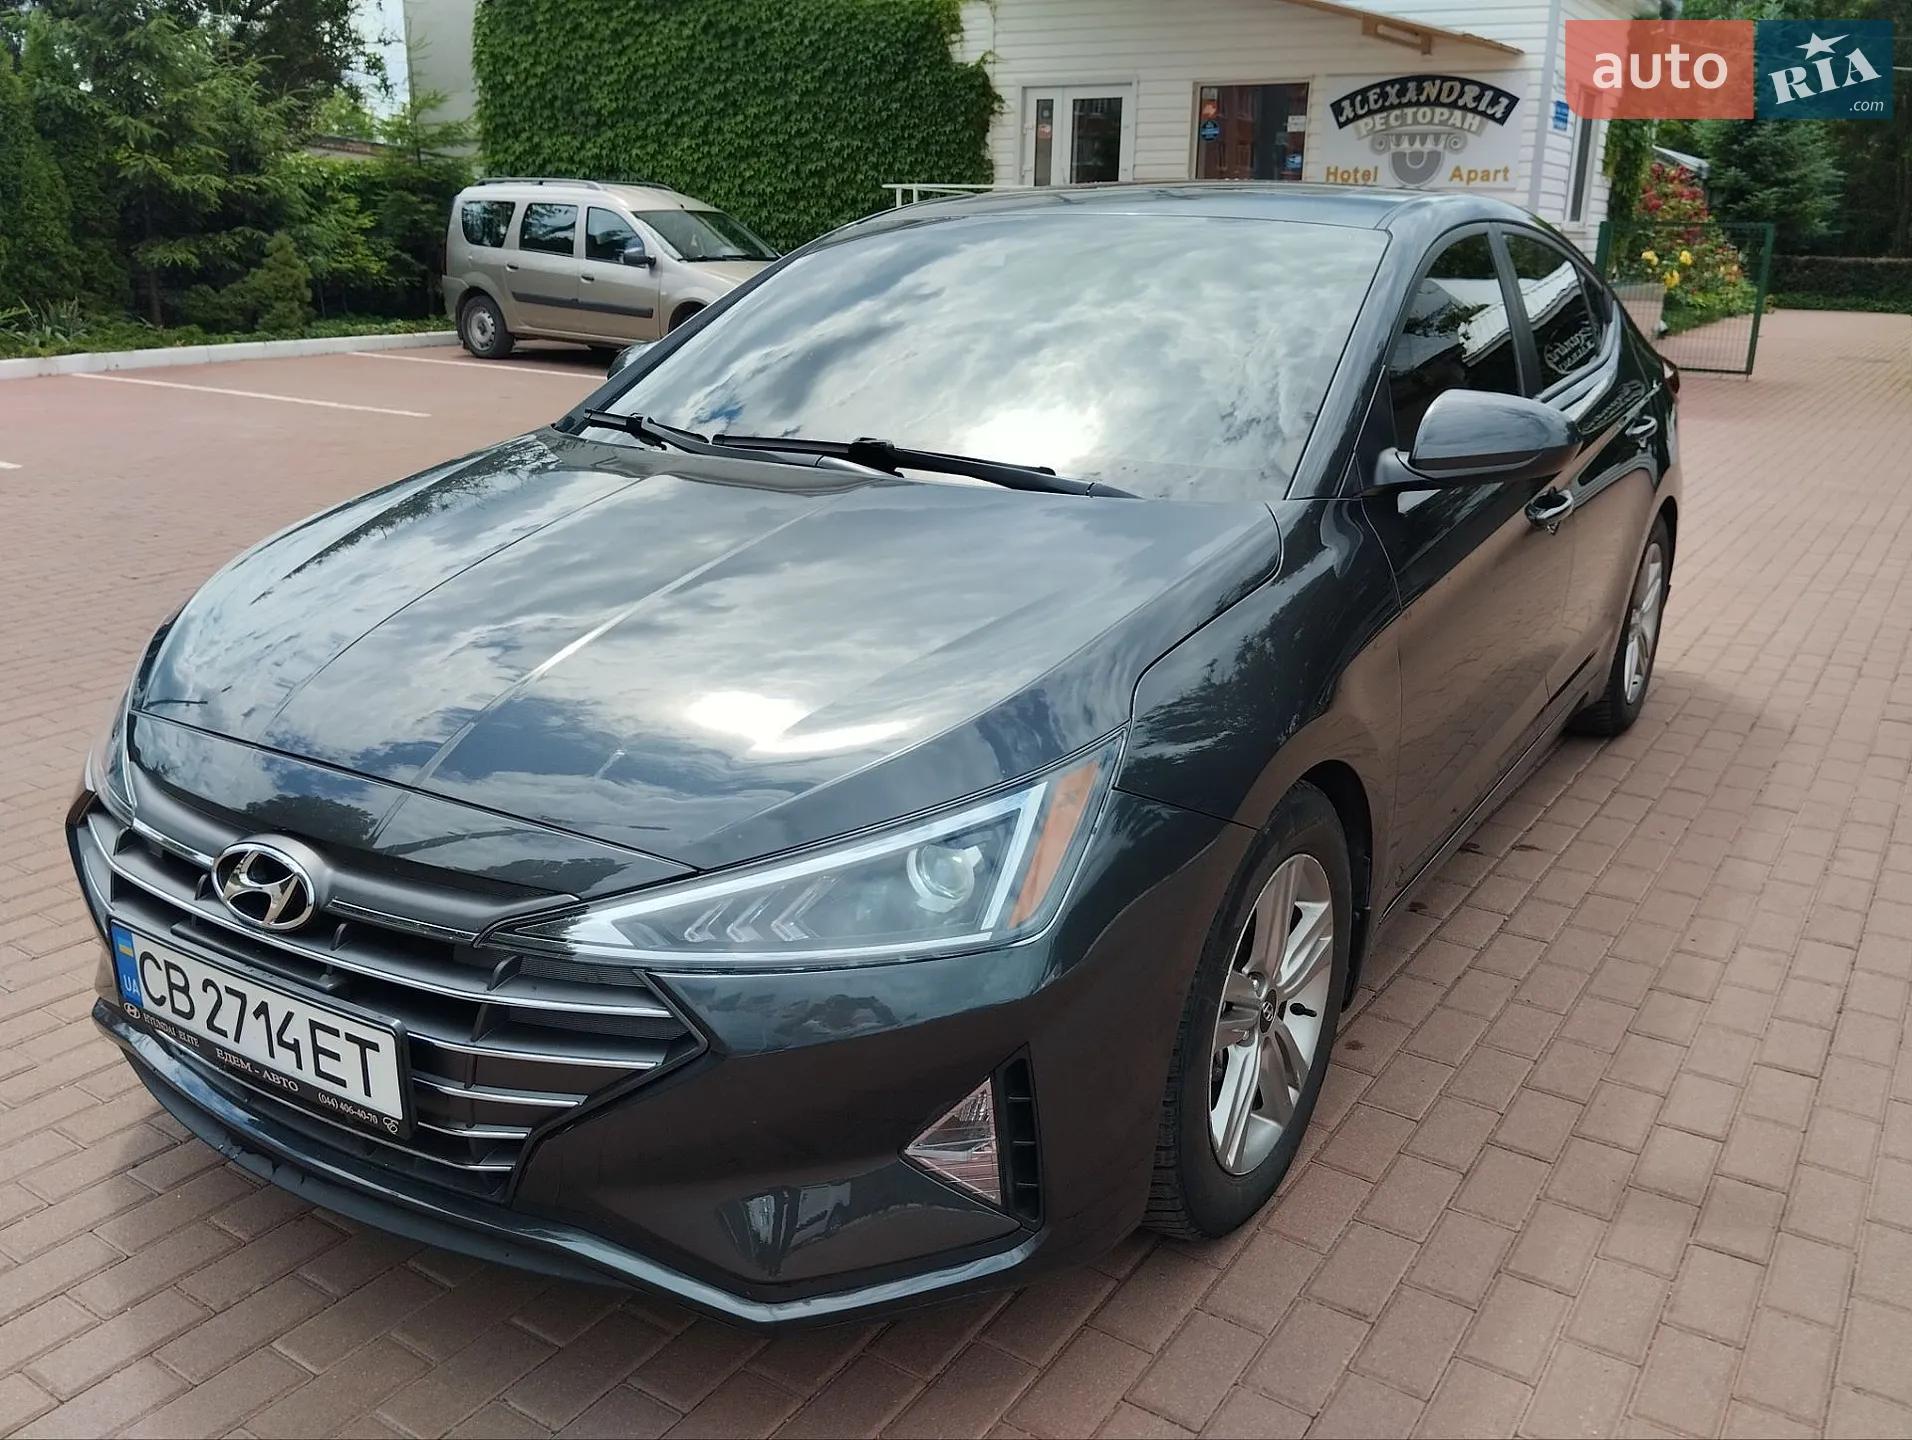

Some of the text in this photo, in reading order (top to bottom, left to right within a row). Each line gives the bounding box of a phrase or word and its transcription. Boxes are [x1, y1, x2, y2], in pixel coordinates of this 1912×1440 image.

[1338, 79, 1510, 123] ALEXANDRIA
[1360, 106, 1483, 135] РЕСТОРАН
[1325, 165, 1510, 185] Hotel Apart
[123, 974, 141, 997] UA
[262, 1070, 299, 1092] АВТО
